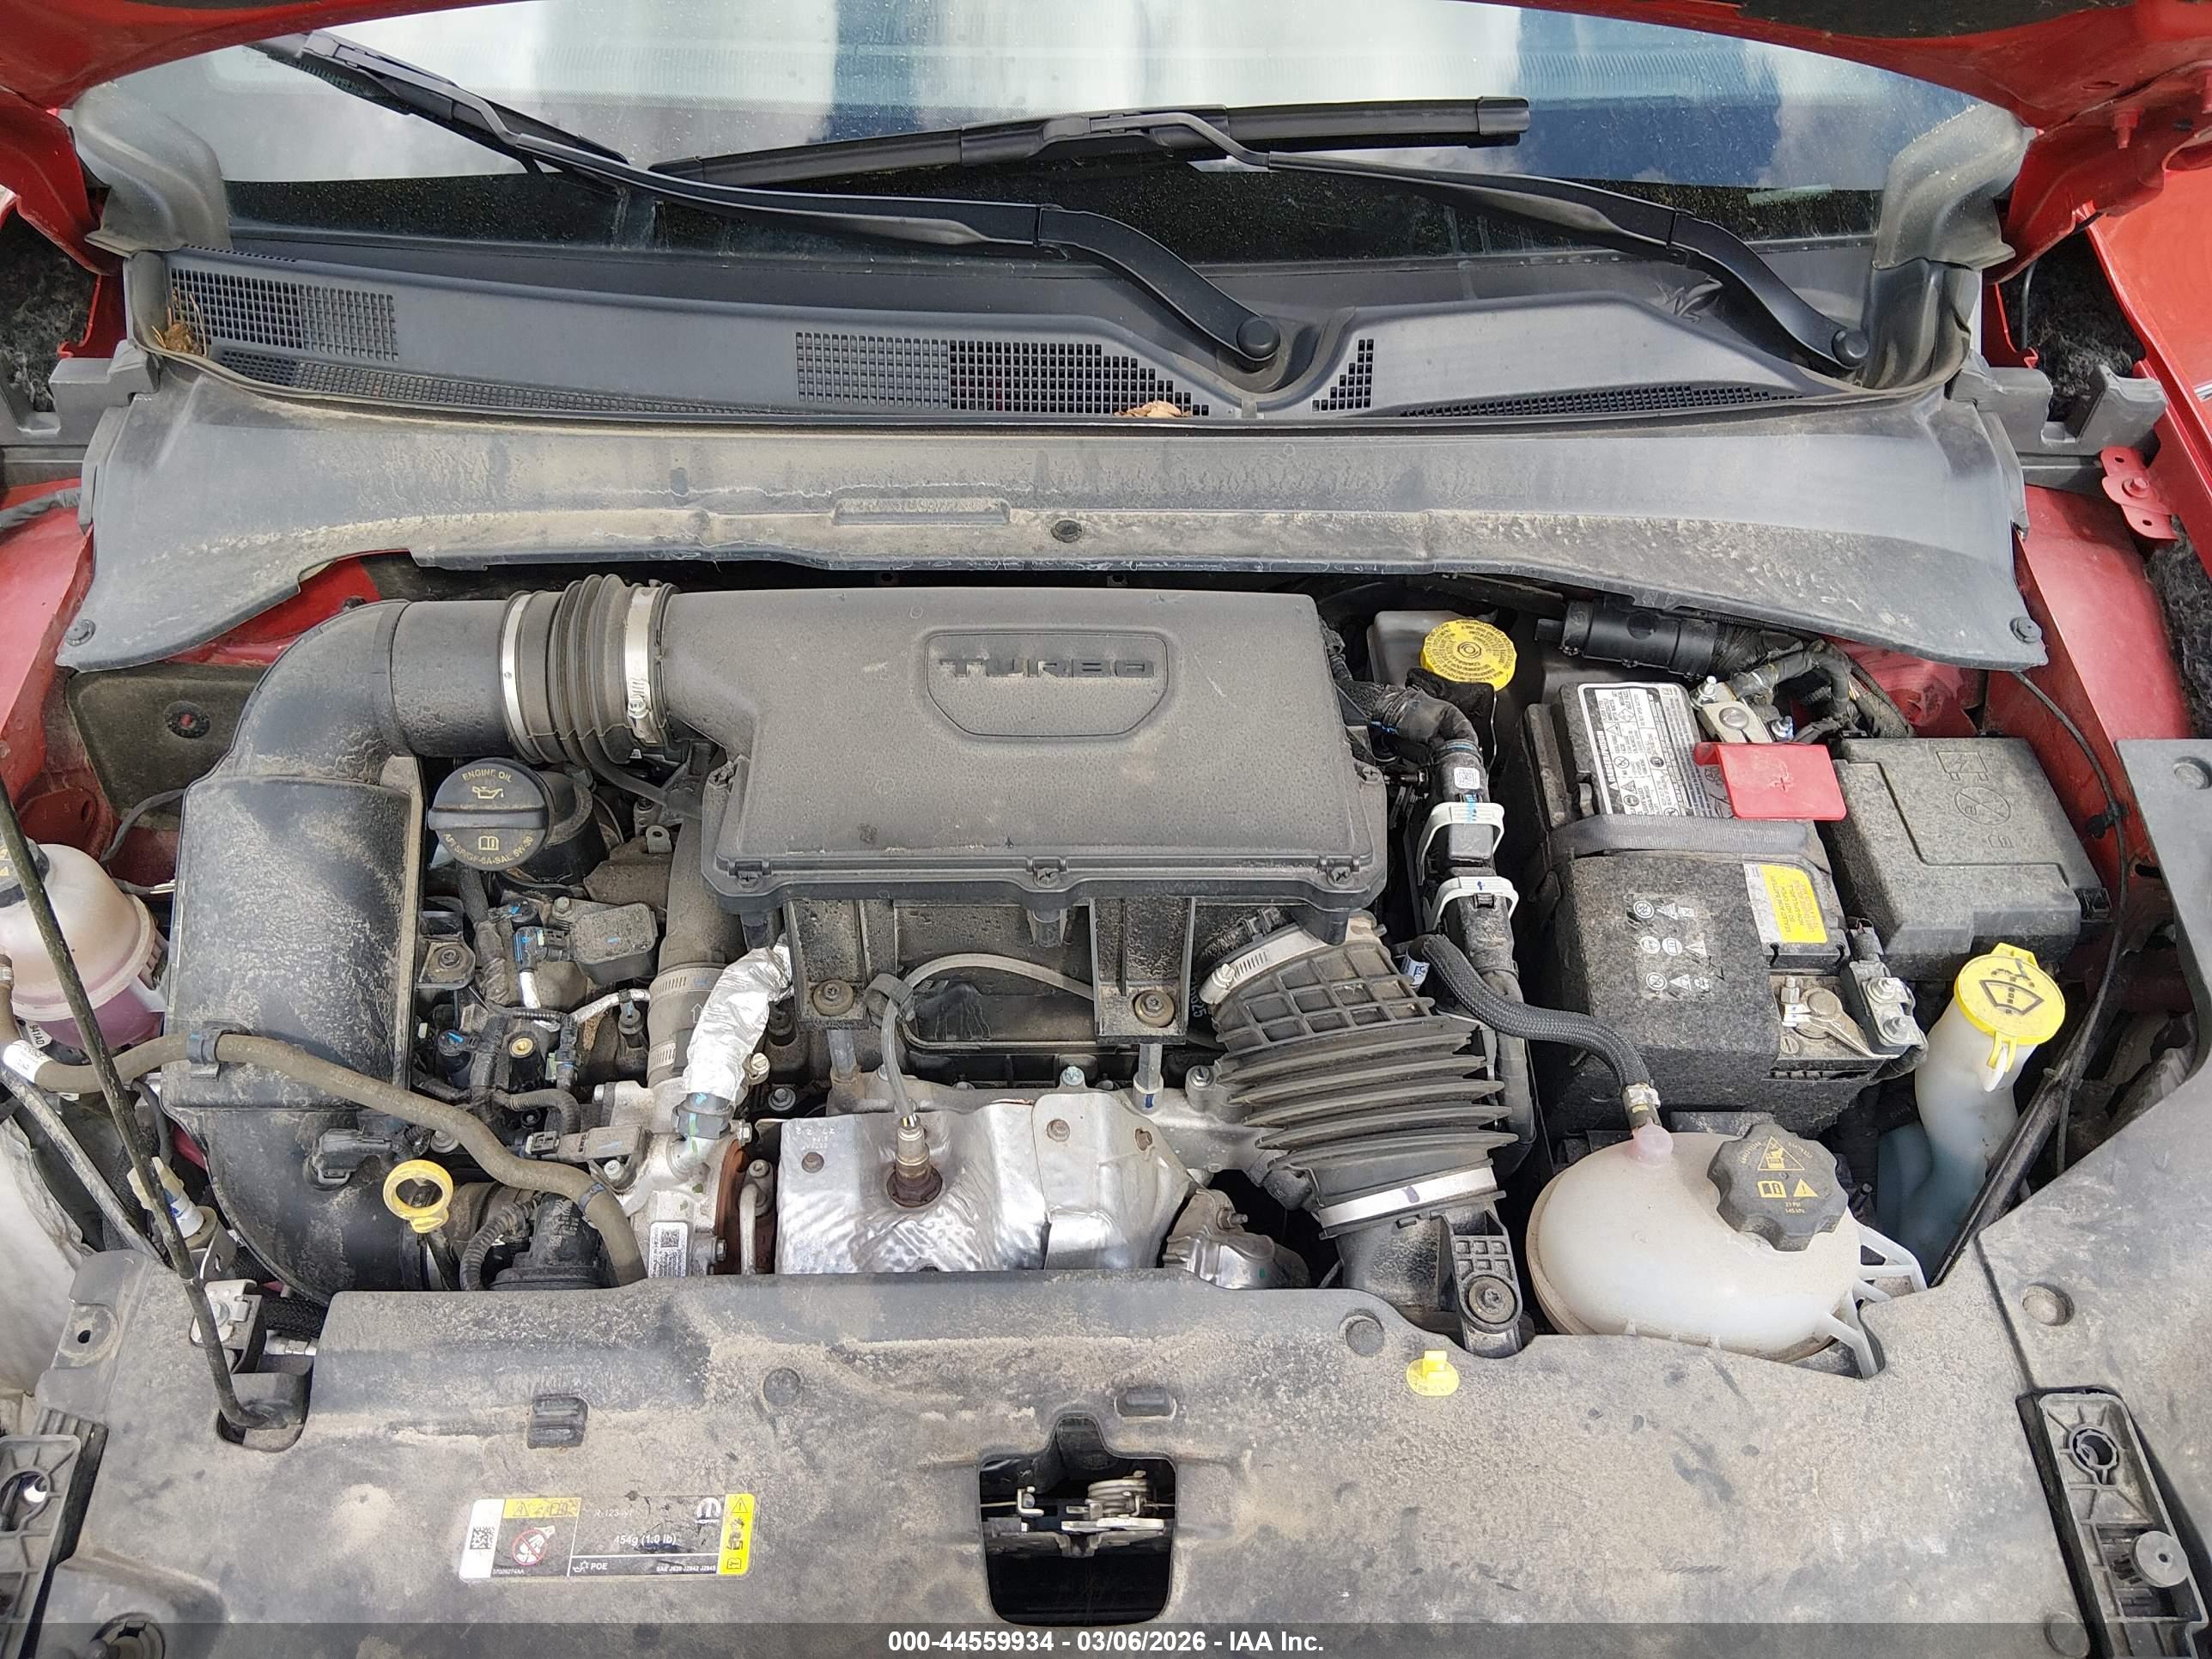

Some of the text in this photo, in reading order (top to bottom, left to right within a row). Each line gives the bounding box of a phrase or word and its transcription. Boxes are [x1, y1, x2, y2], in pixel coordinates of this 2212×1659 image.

[940, 659, 1155, 678] TURBO
[462, 769, 513, 783] ENGINE OIL
[641, 1534, 660, 1546] (1.0
[663, 1534, 677, 1546] lb)
